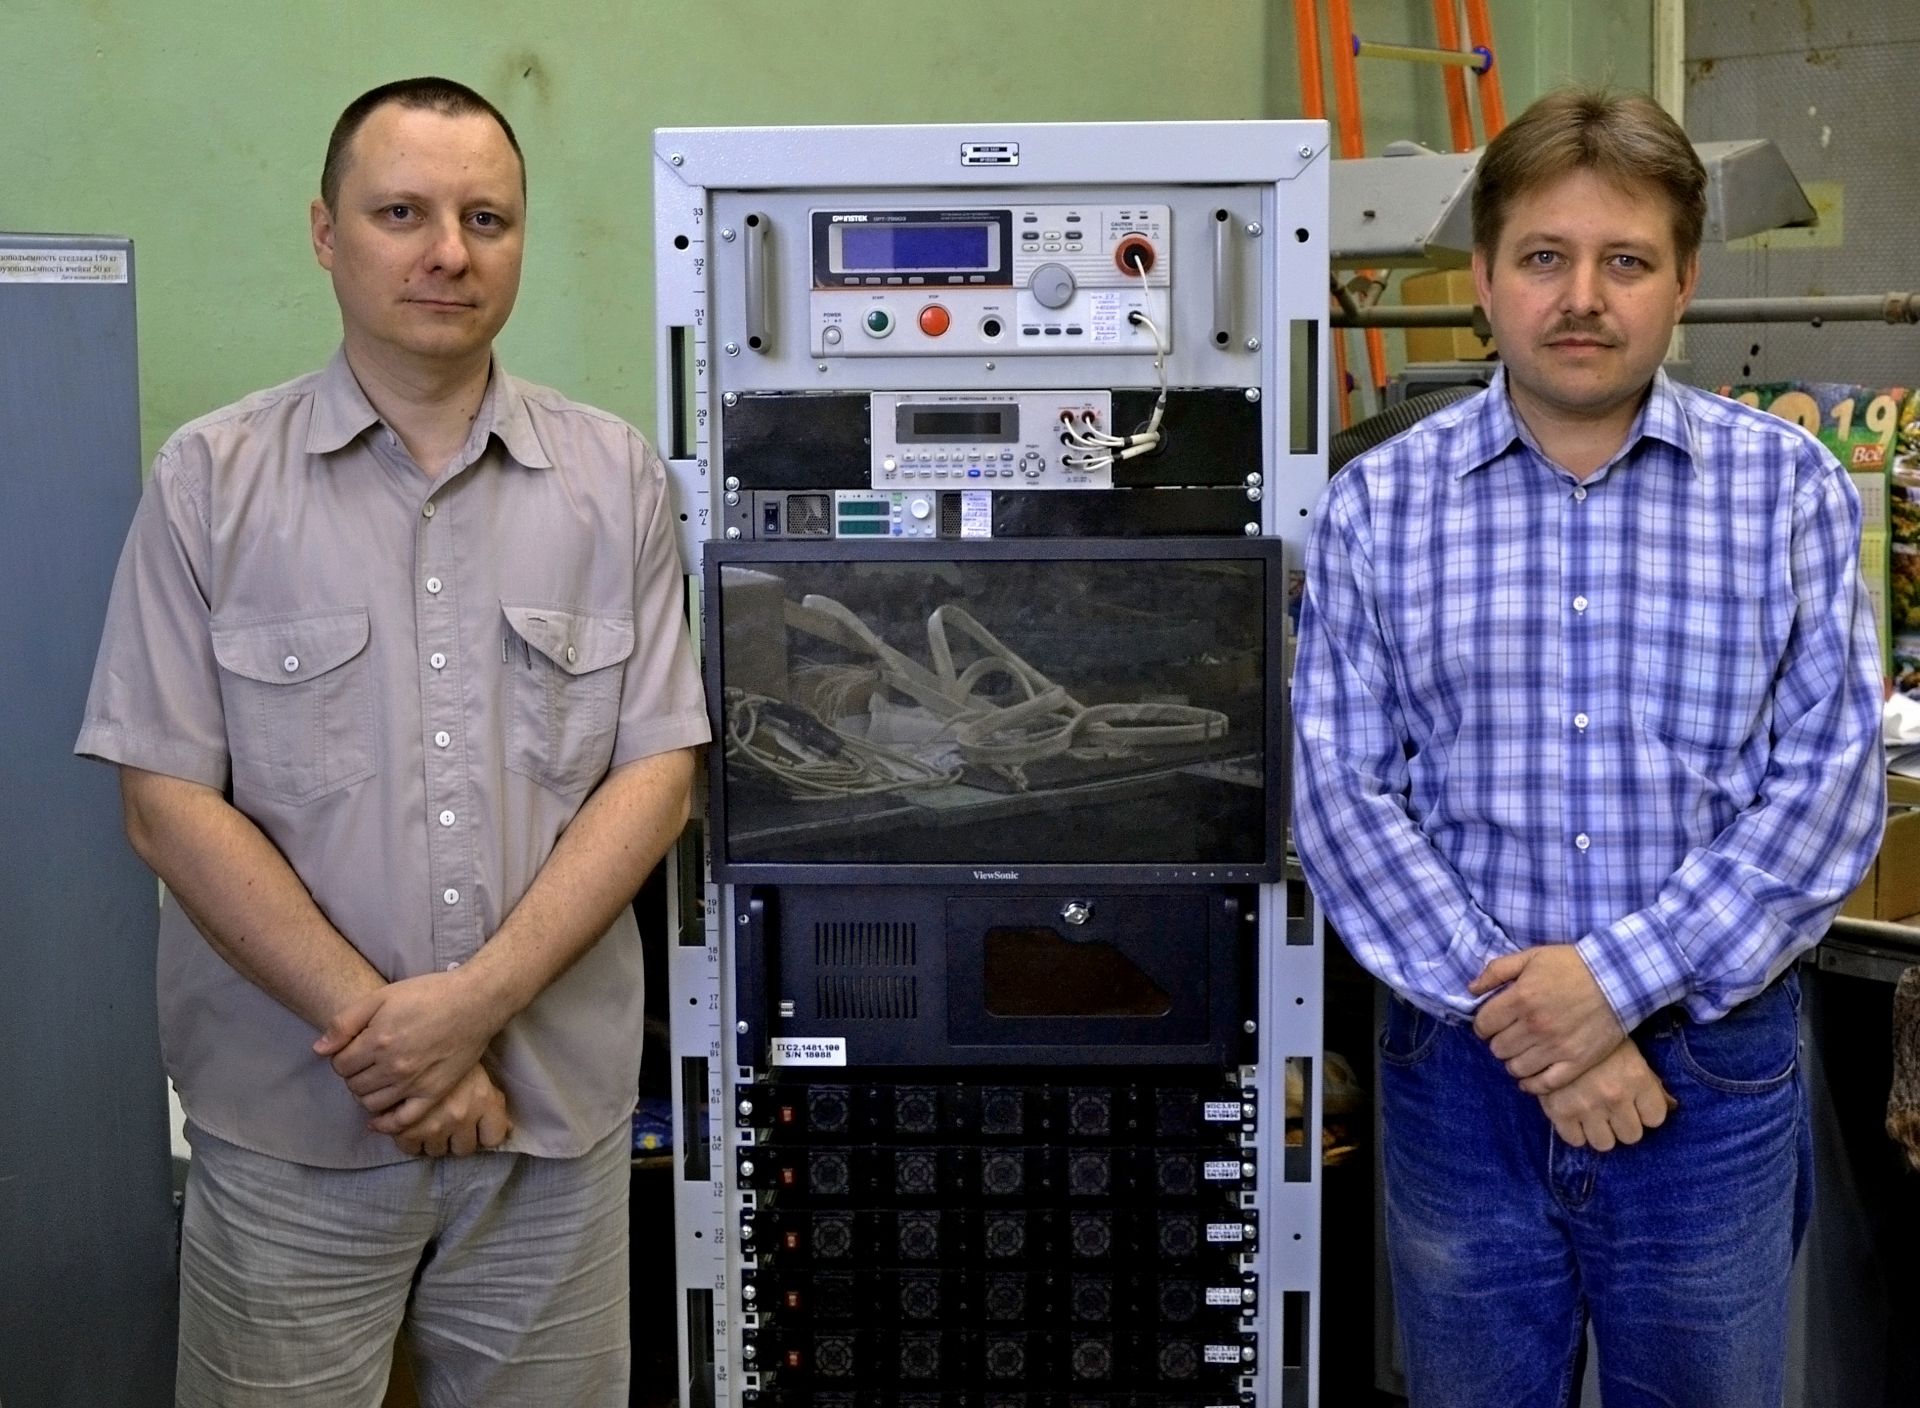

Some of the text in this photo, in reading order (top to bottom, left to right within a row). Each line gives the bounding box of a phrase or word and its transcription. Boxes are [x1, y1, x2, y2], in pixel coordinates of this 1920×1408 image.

[693, 207, 704, 216] 33
[95, 254, 108, 262] 150
[694, 258, 705, 267] 32
[93, 265, 102, 273] 50
[695, 309, 705, 317] 31
[695, 359, 707, 368] 30
[696, 409, 708, 418] 29
[697, 458, 709, 470] 28
[698, 508, 709, 520] 27
[973, 870, 1019, 880] ViewSonic
